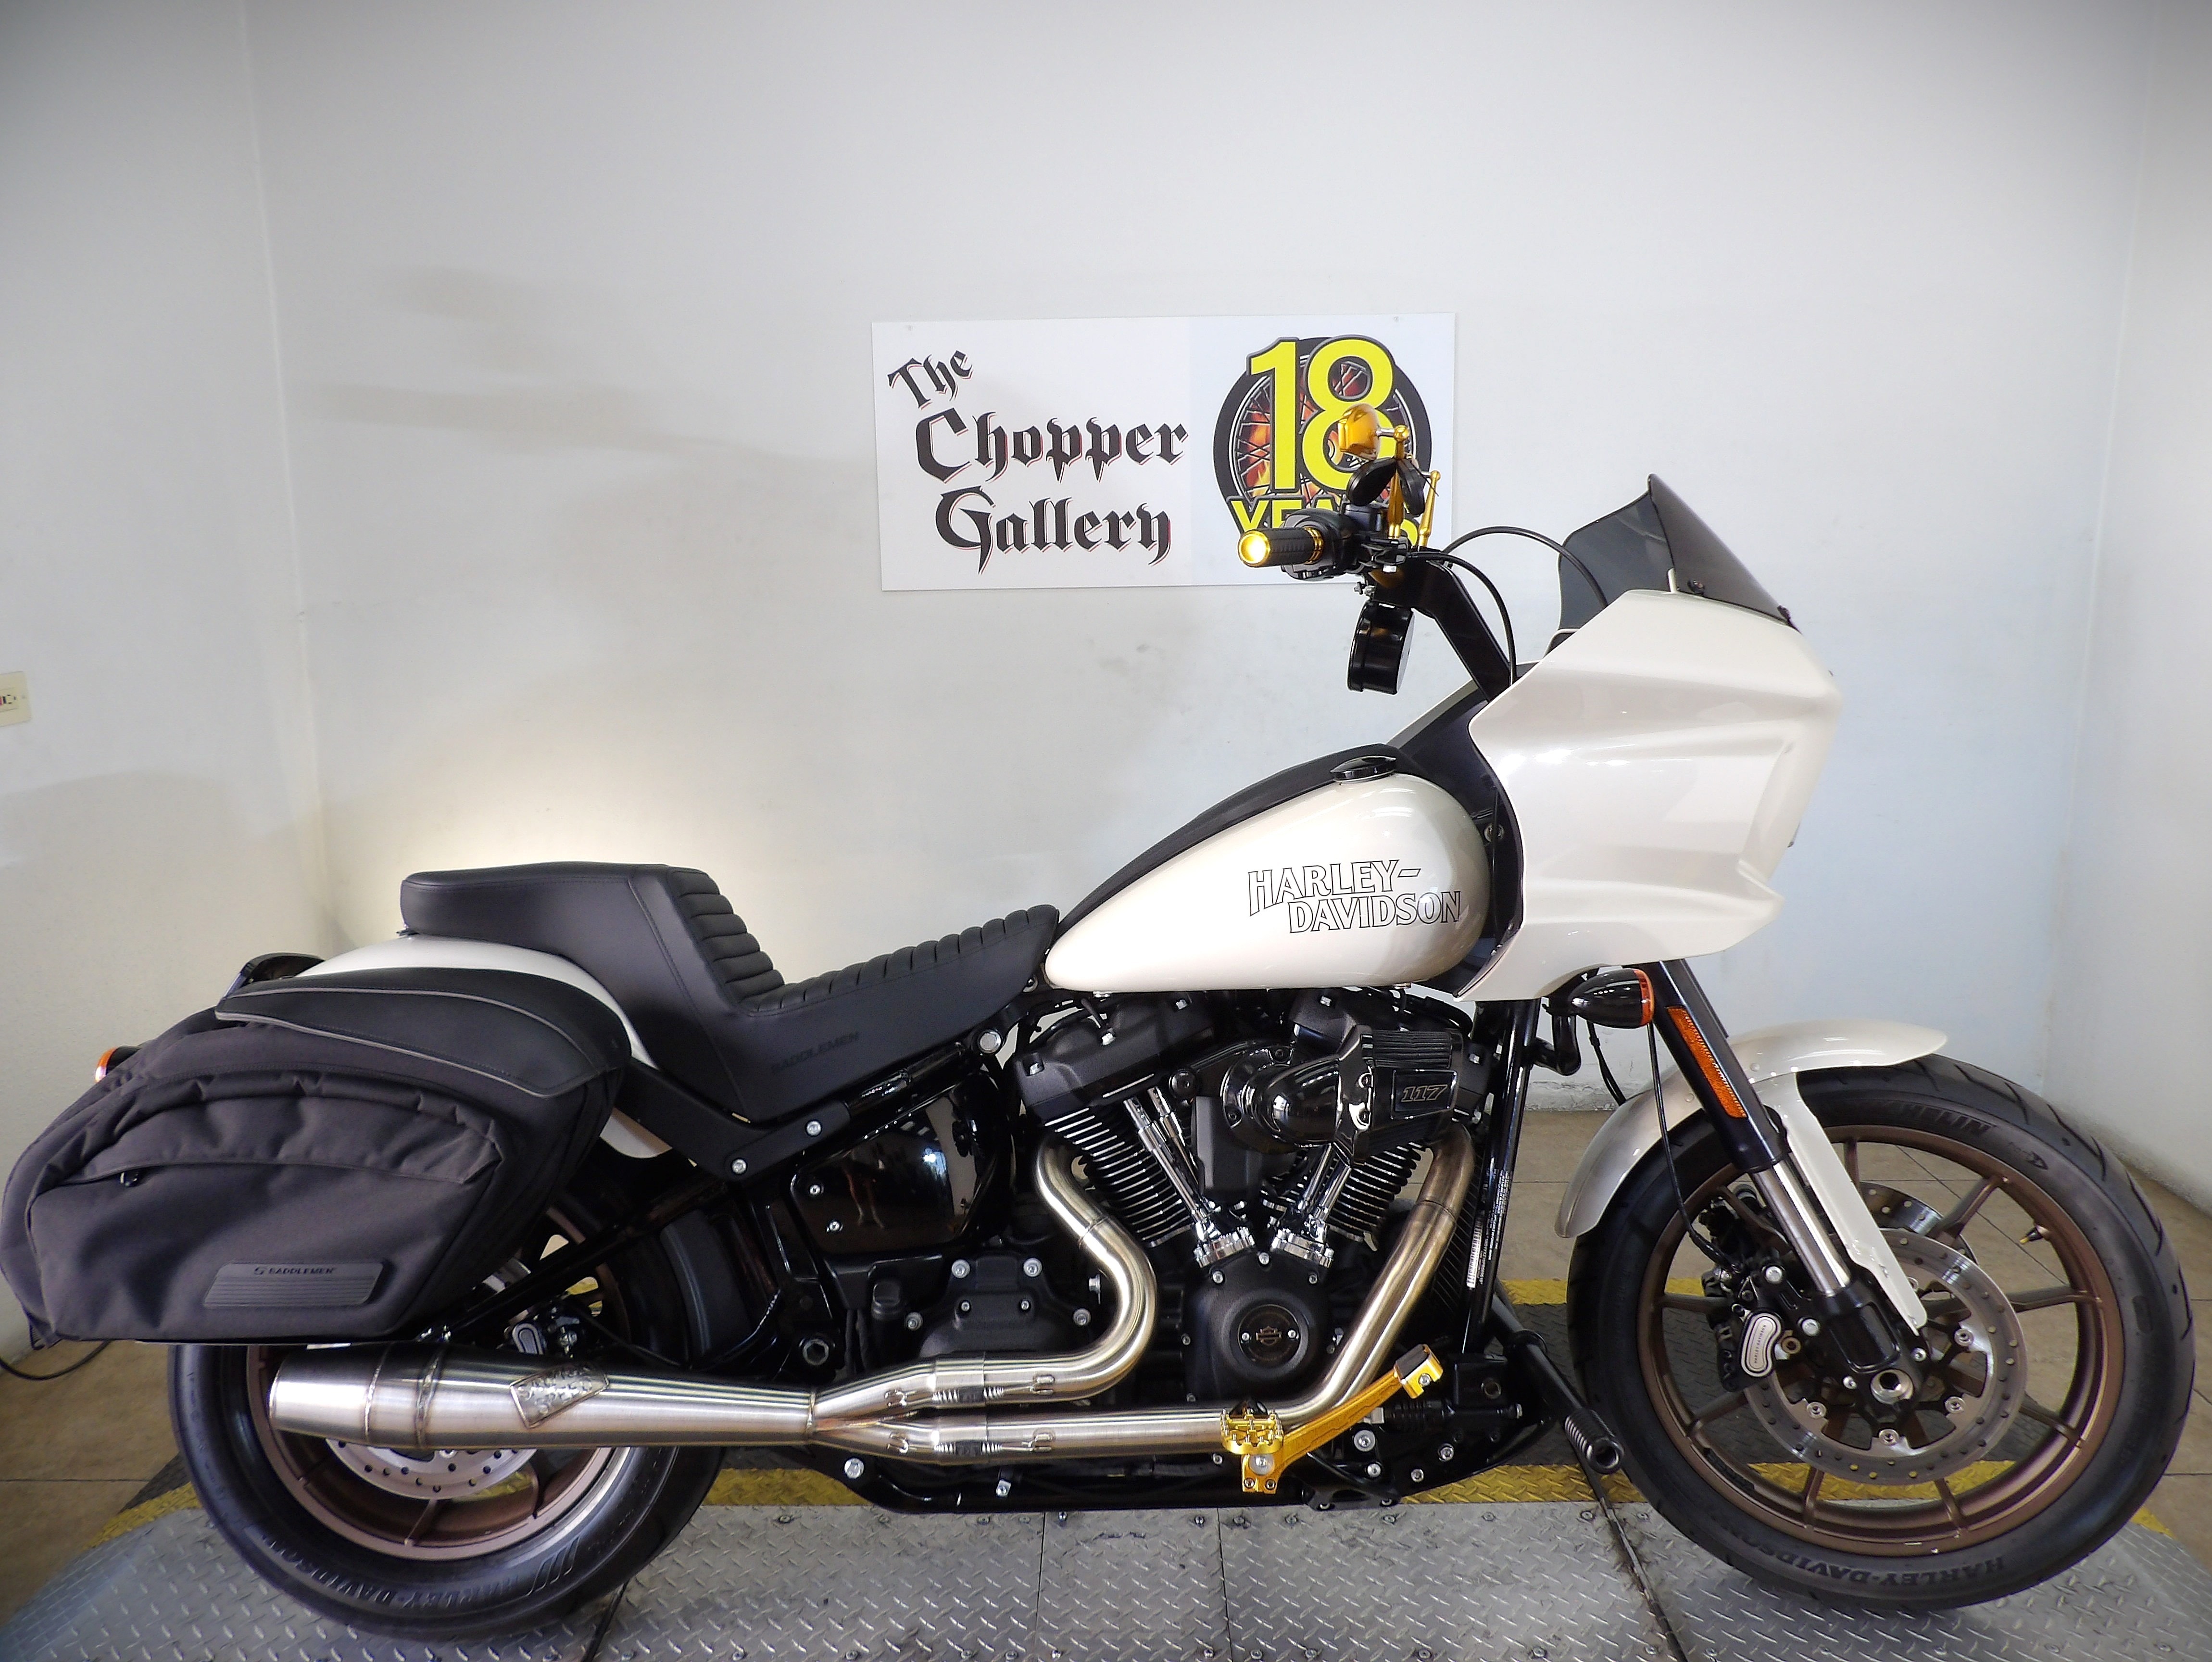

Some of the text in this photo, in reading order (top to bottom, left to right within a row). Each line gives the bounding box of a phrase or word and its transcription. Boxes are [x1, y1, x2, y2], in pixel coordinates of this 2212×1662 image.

[887, 350, 973, 410] The
[1246, 334, 1397, 495] 18
[916, 407, 1189, 483] Chopper
[935, 485, 1171, 575] Gallery
[1248, 859, 1421, 917] HARLEY-
[1288, 891, 1461, 933] DAVIDSON
[1401, 1084, 1449, 1103] 117
